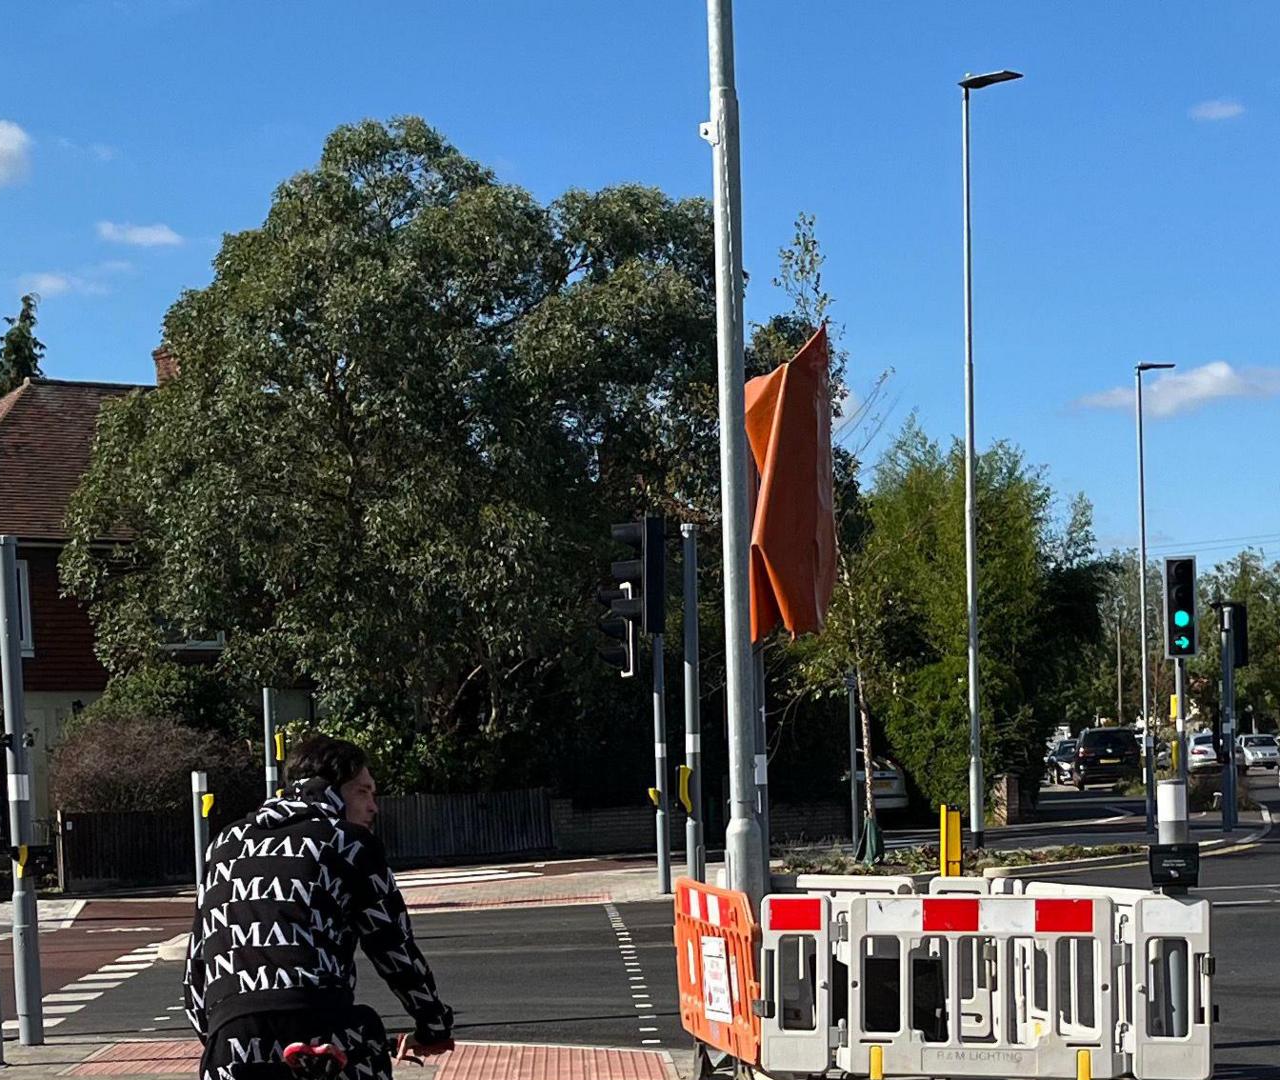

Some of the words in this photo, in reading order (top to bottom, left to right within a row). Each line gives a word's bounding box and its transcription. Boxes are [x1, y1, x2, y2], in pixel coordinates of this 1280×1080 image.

[237, 835, 328, 863] MAN
[230, 875, 318, 907] MAN
[230, 920, 318, 949] MAN
[237, 964, 320, 995] MAN
[968, 1052, 1023, 1064] LIGHTING
